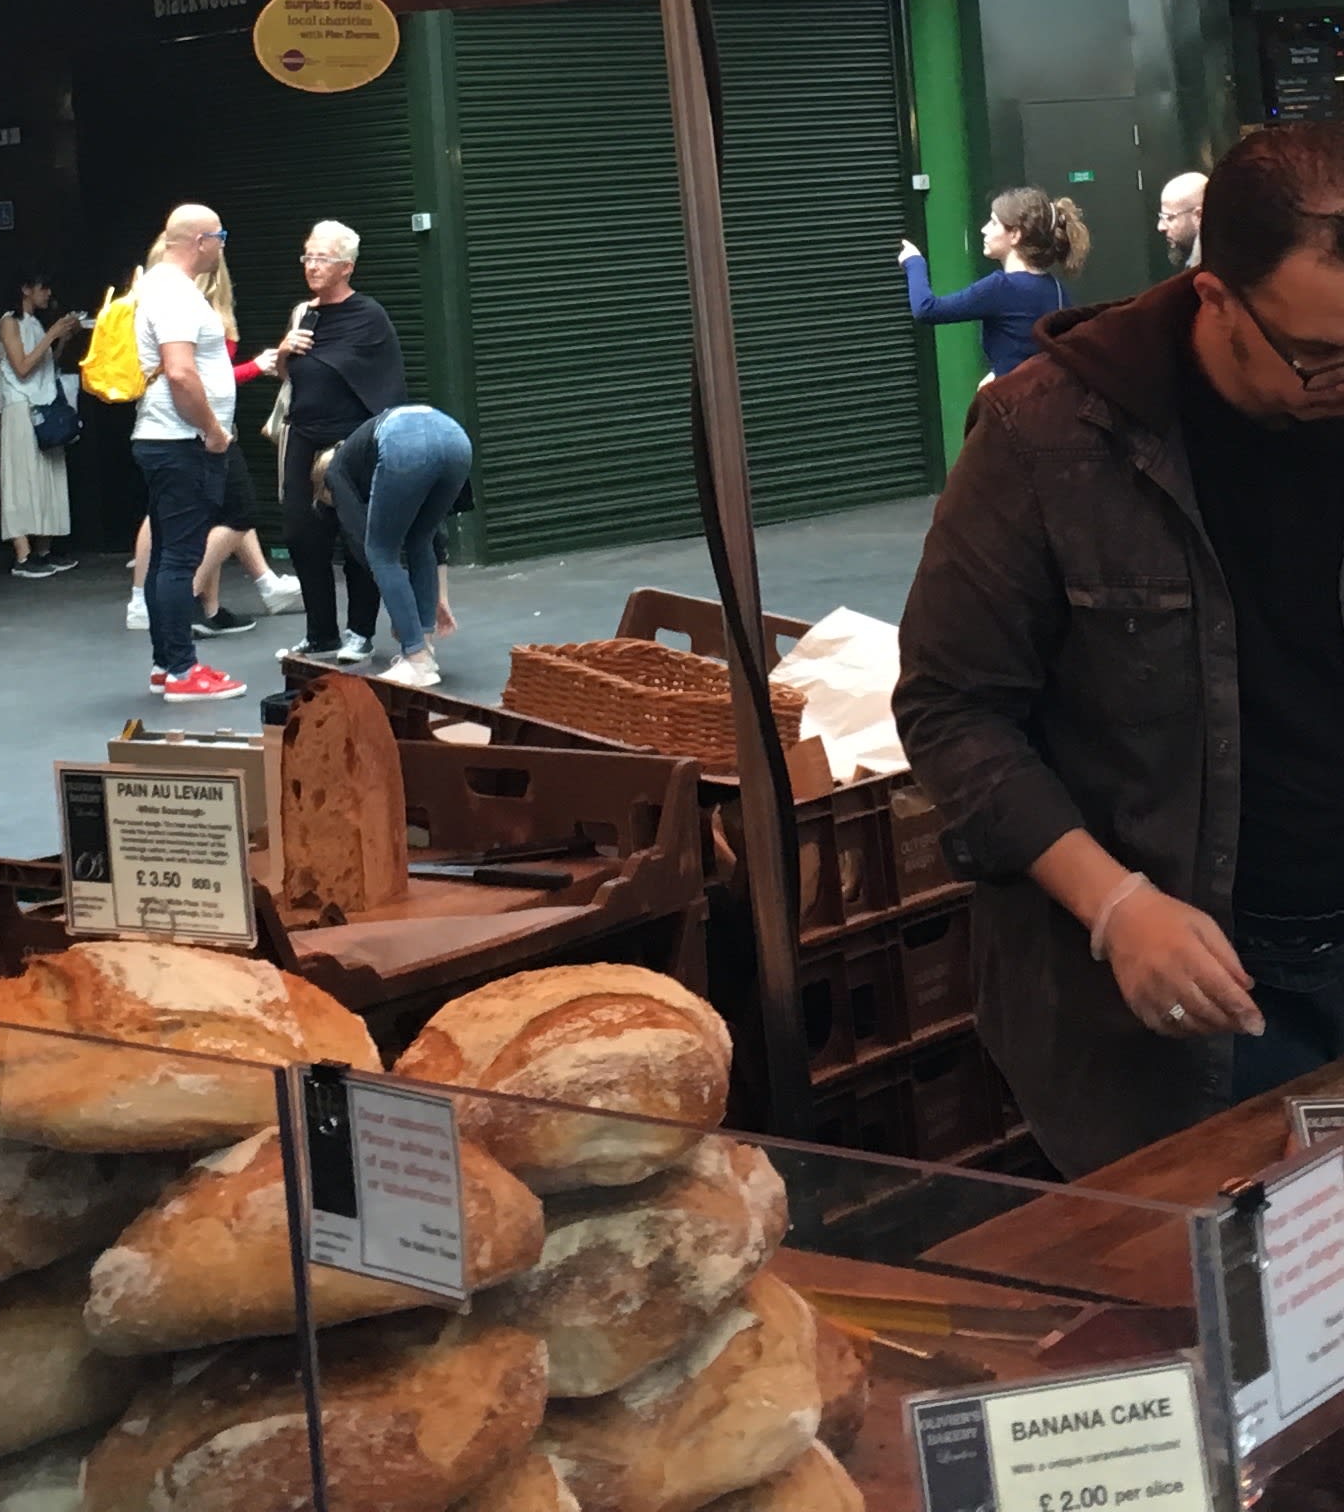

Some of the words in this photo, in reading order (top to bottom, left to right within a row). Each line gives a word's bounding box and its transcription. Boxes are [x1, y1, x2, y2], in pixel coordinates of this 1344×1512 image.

[287, 14, 317, 26] local
[117, 782, 148, 798] PAIN
[151, 784, 171, 799] AU
[173, 785, 224, 801] LEVAIN
[136, 870, 146, 887] £
[149, 870, 181, 888] 3.50
[1011, 1410, 1105, 1441] BANANA
[1110, 1397, 1174, 1425] CAKE
[1060, 1484, 1109, 1512] 2.00
[1115, 1488, 1141, 1506] per
[1146, 1479, 1184, 1498] slice
